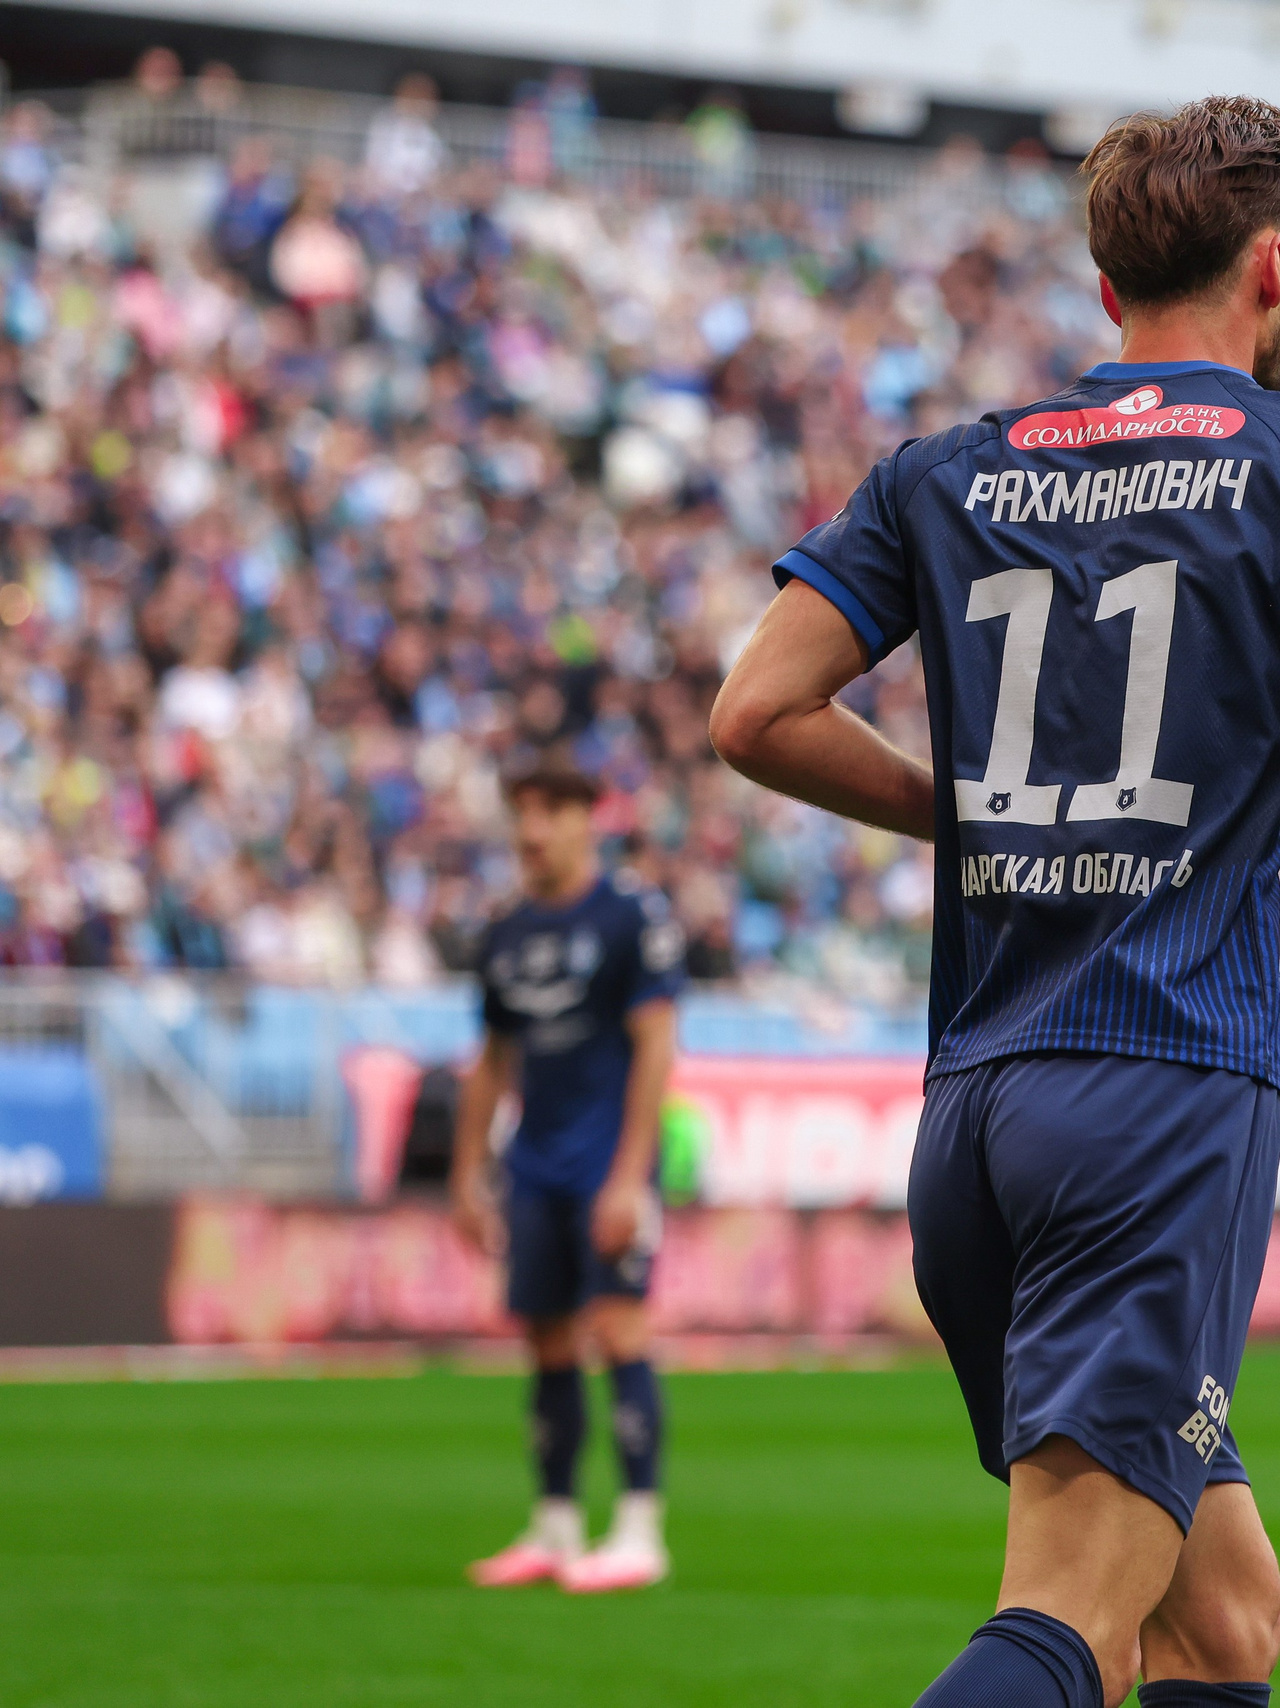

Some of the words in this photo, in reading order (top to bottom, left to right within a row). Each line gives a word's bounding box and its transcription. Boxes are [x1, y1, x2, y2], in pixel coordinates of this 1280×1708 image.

[1022, 417, 1225, 447] СОЛИДАРНОСТЬ
[1172, 407, 1223, 419] БАНК
[964, 459, 1252, 523] РАХМАНОВИЧ
[953, 559, 1194, 827] 11
[1072, 849, 1193, 898] ОБЛАСЬ
[1197, 1374, 1230, 1434] FON
[1177, 1409, 1221, 1465] BET
